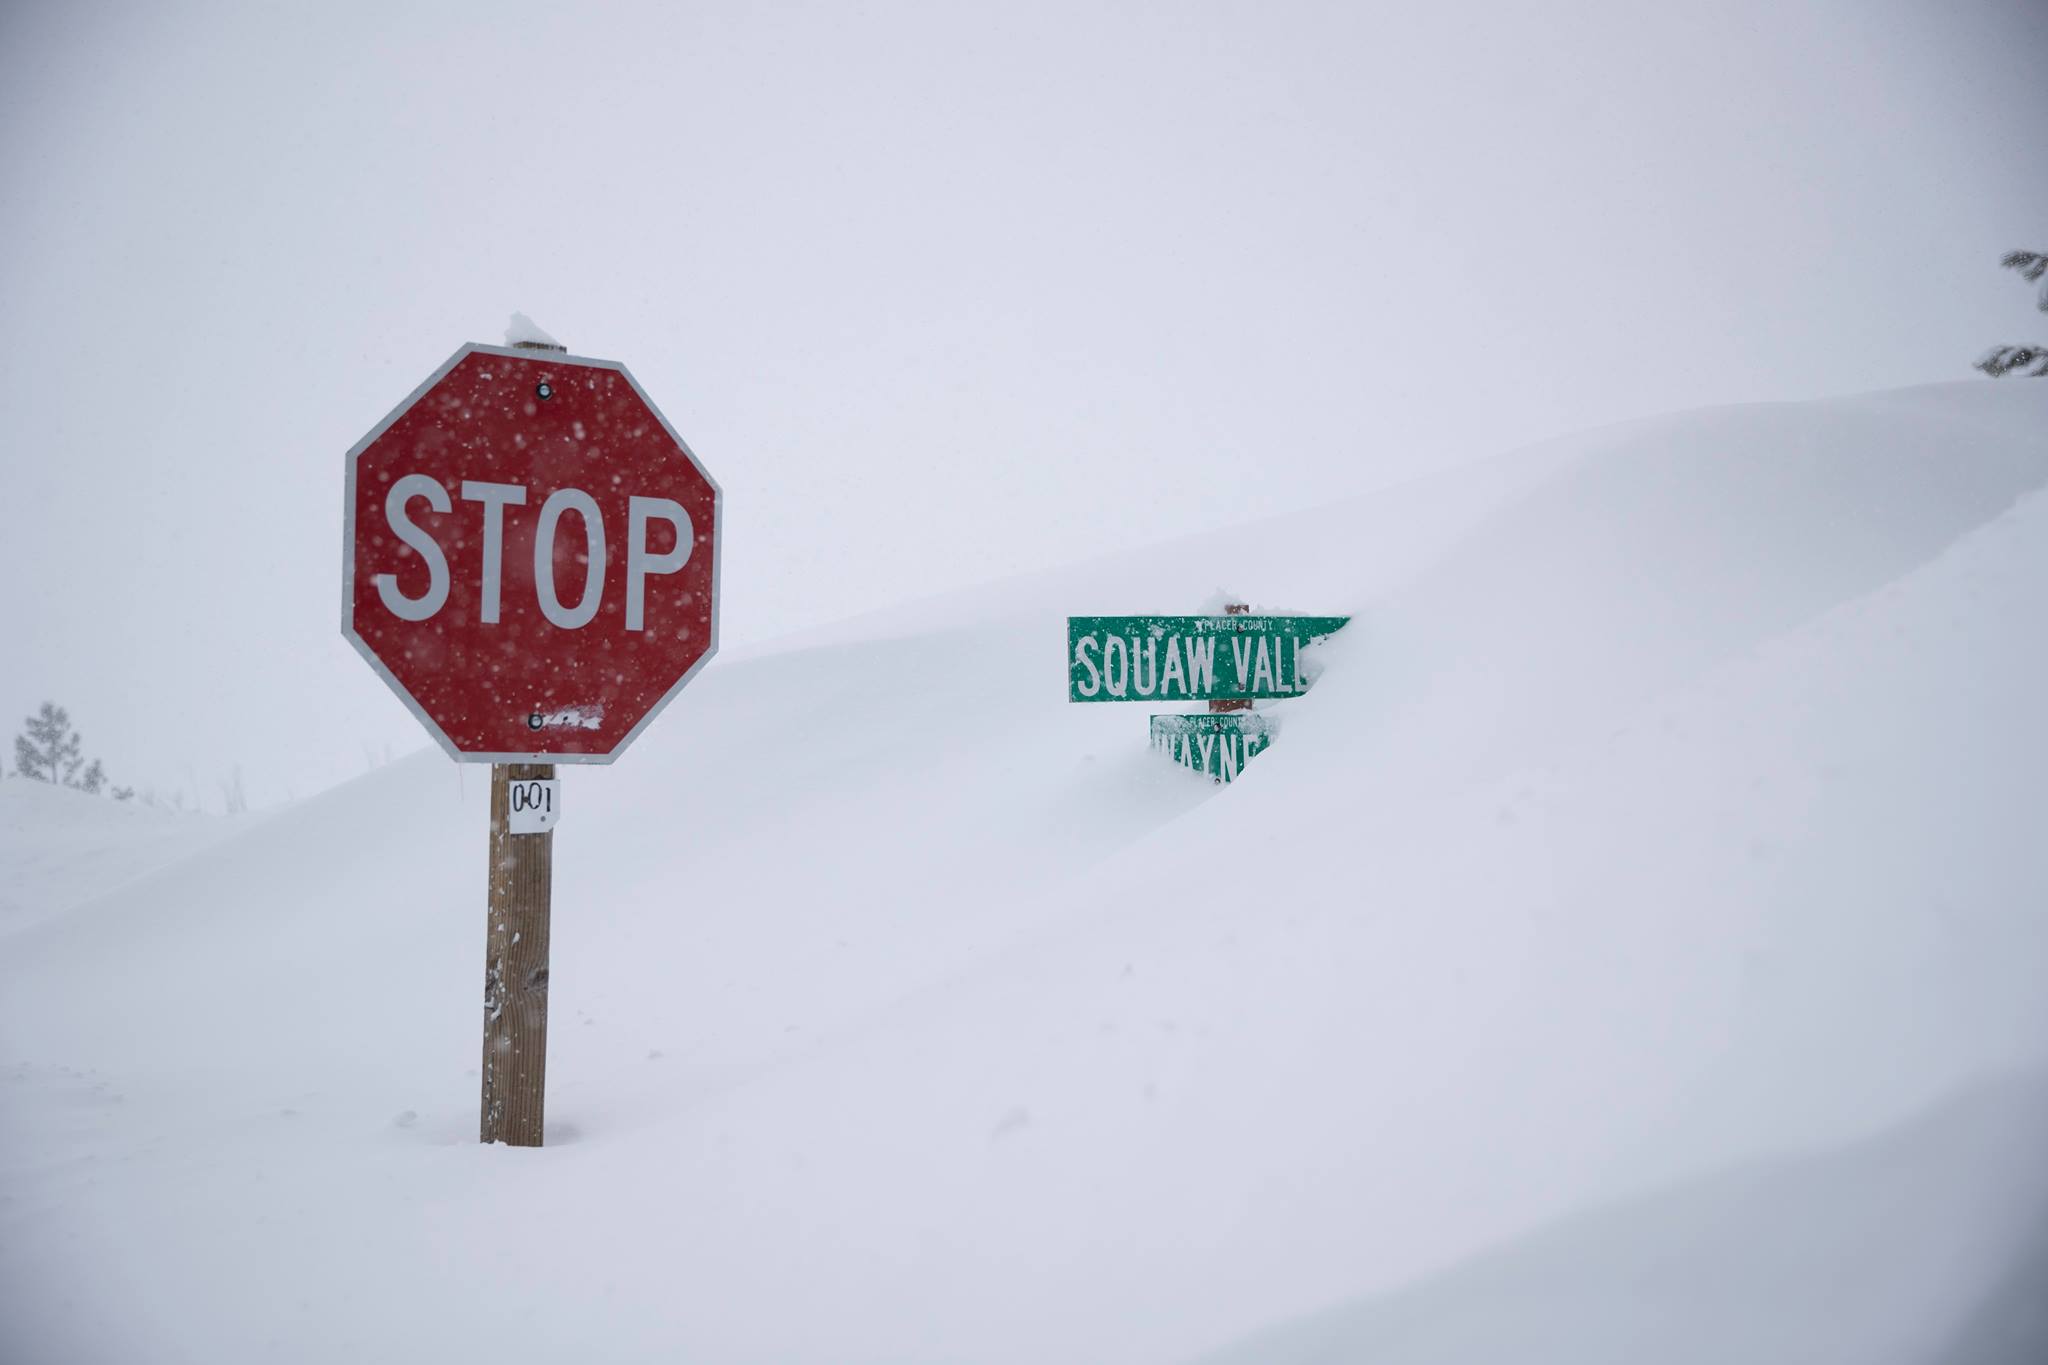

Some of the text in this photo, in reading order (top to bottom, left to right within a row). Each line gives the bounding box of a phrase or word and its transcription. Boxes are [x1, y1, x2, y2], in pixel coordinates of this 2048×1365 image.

[377, 474, 694, 631] STOP
[1204, 620, 1273, 631] PLACER COUNTY
[1076, 636, 1215, 696] SQUAW
